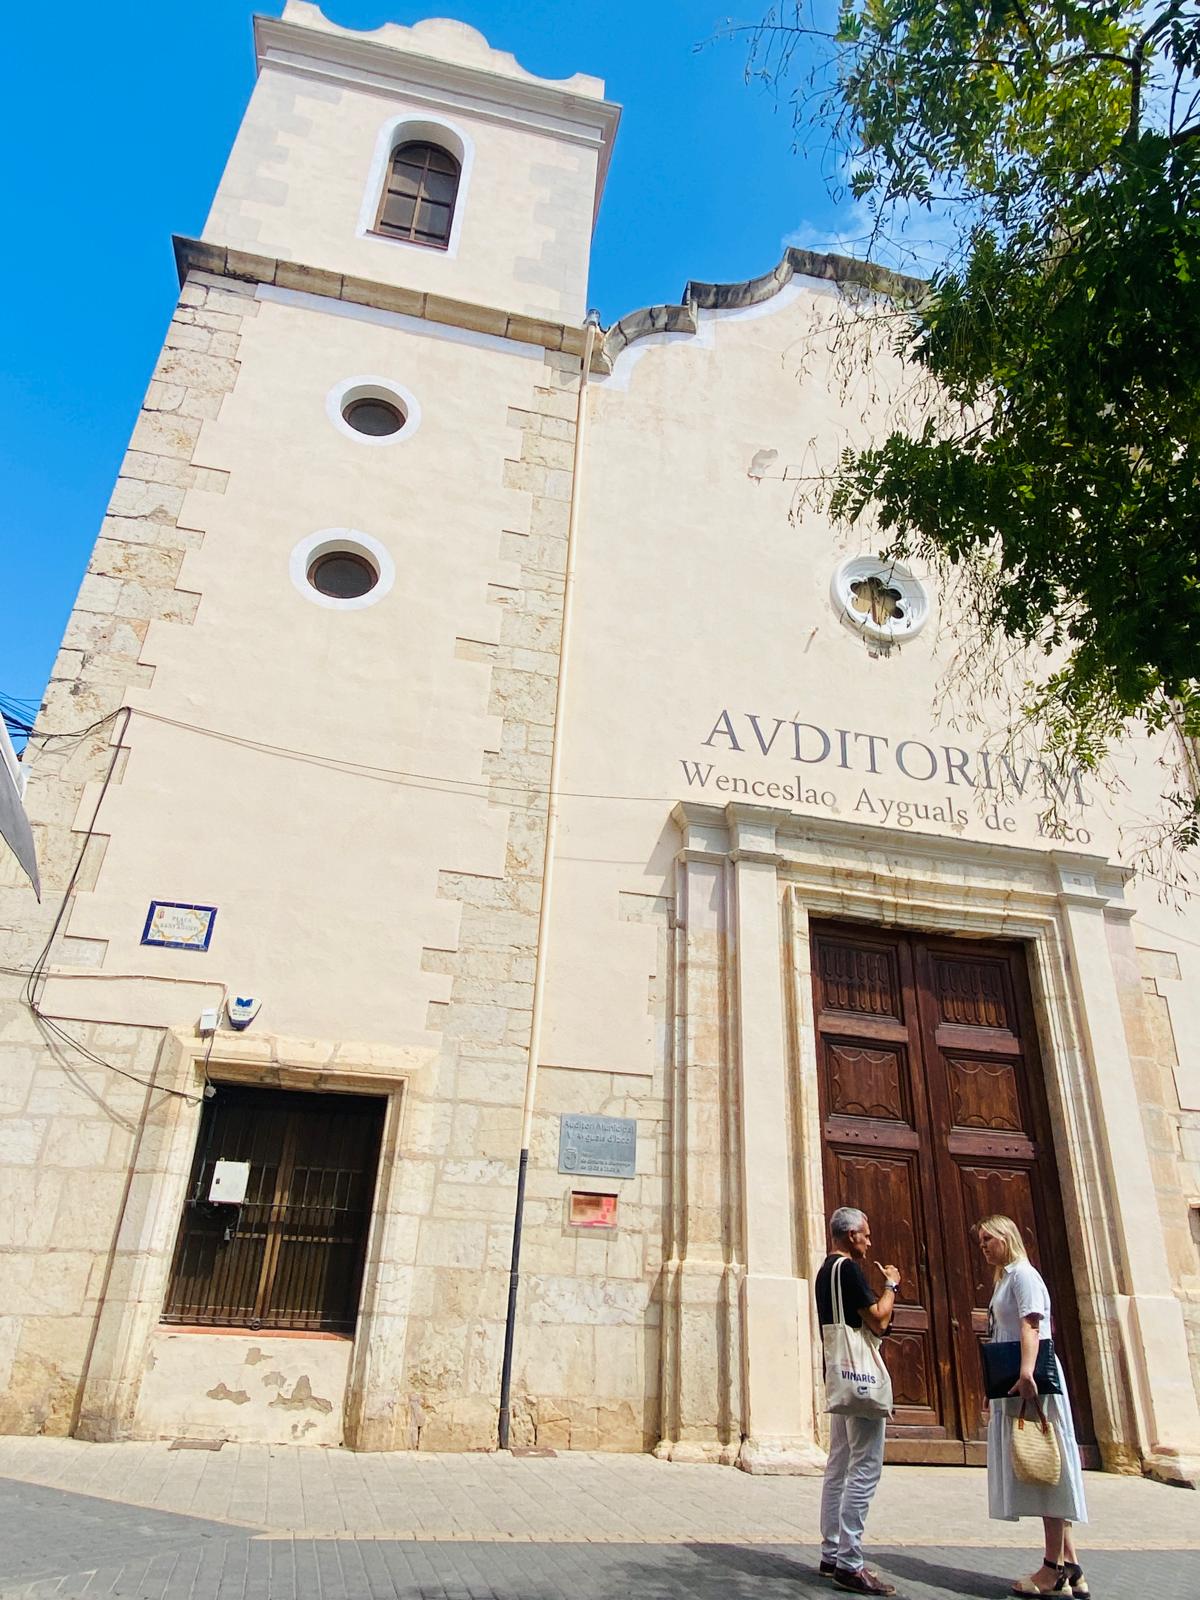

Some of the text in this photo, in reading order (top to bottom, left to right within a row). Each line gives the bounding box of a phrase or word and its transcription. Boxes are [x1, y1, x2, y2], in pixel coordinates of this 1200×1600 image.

[680, 759, 837, 808] Wenceslao
[854, 787, 969, 828] Ayguals
[985, 804, 1017, 832] de
[701, 709, 1093, 807] AVDITORIVM
